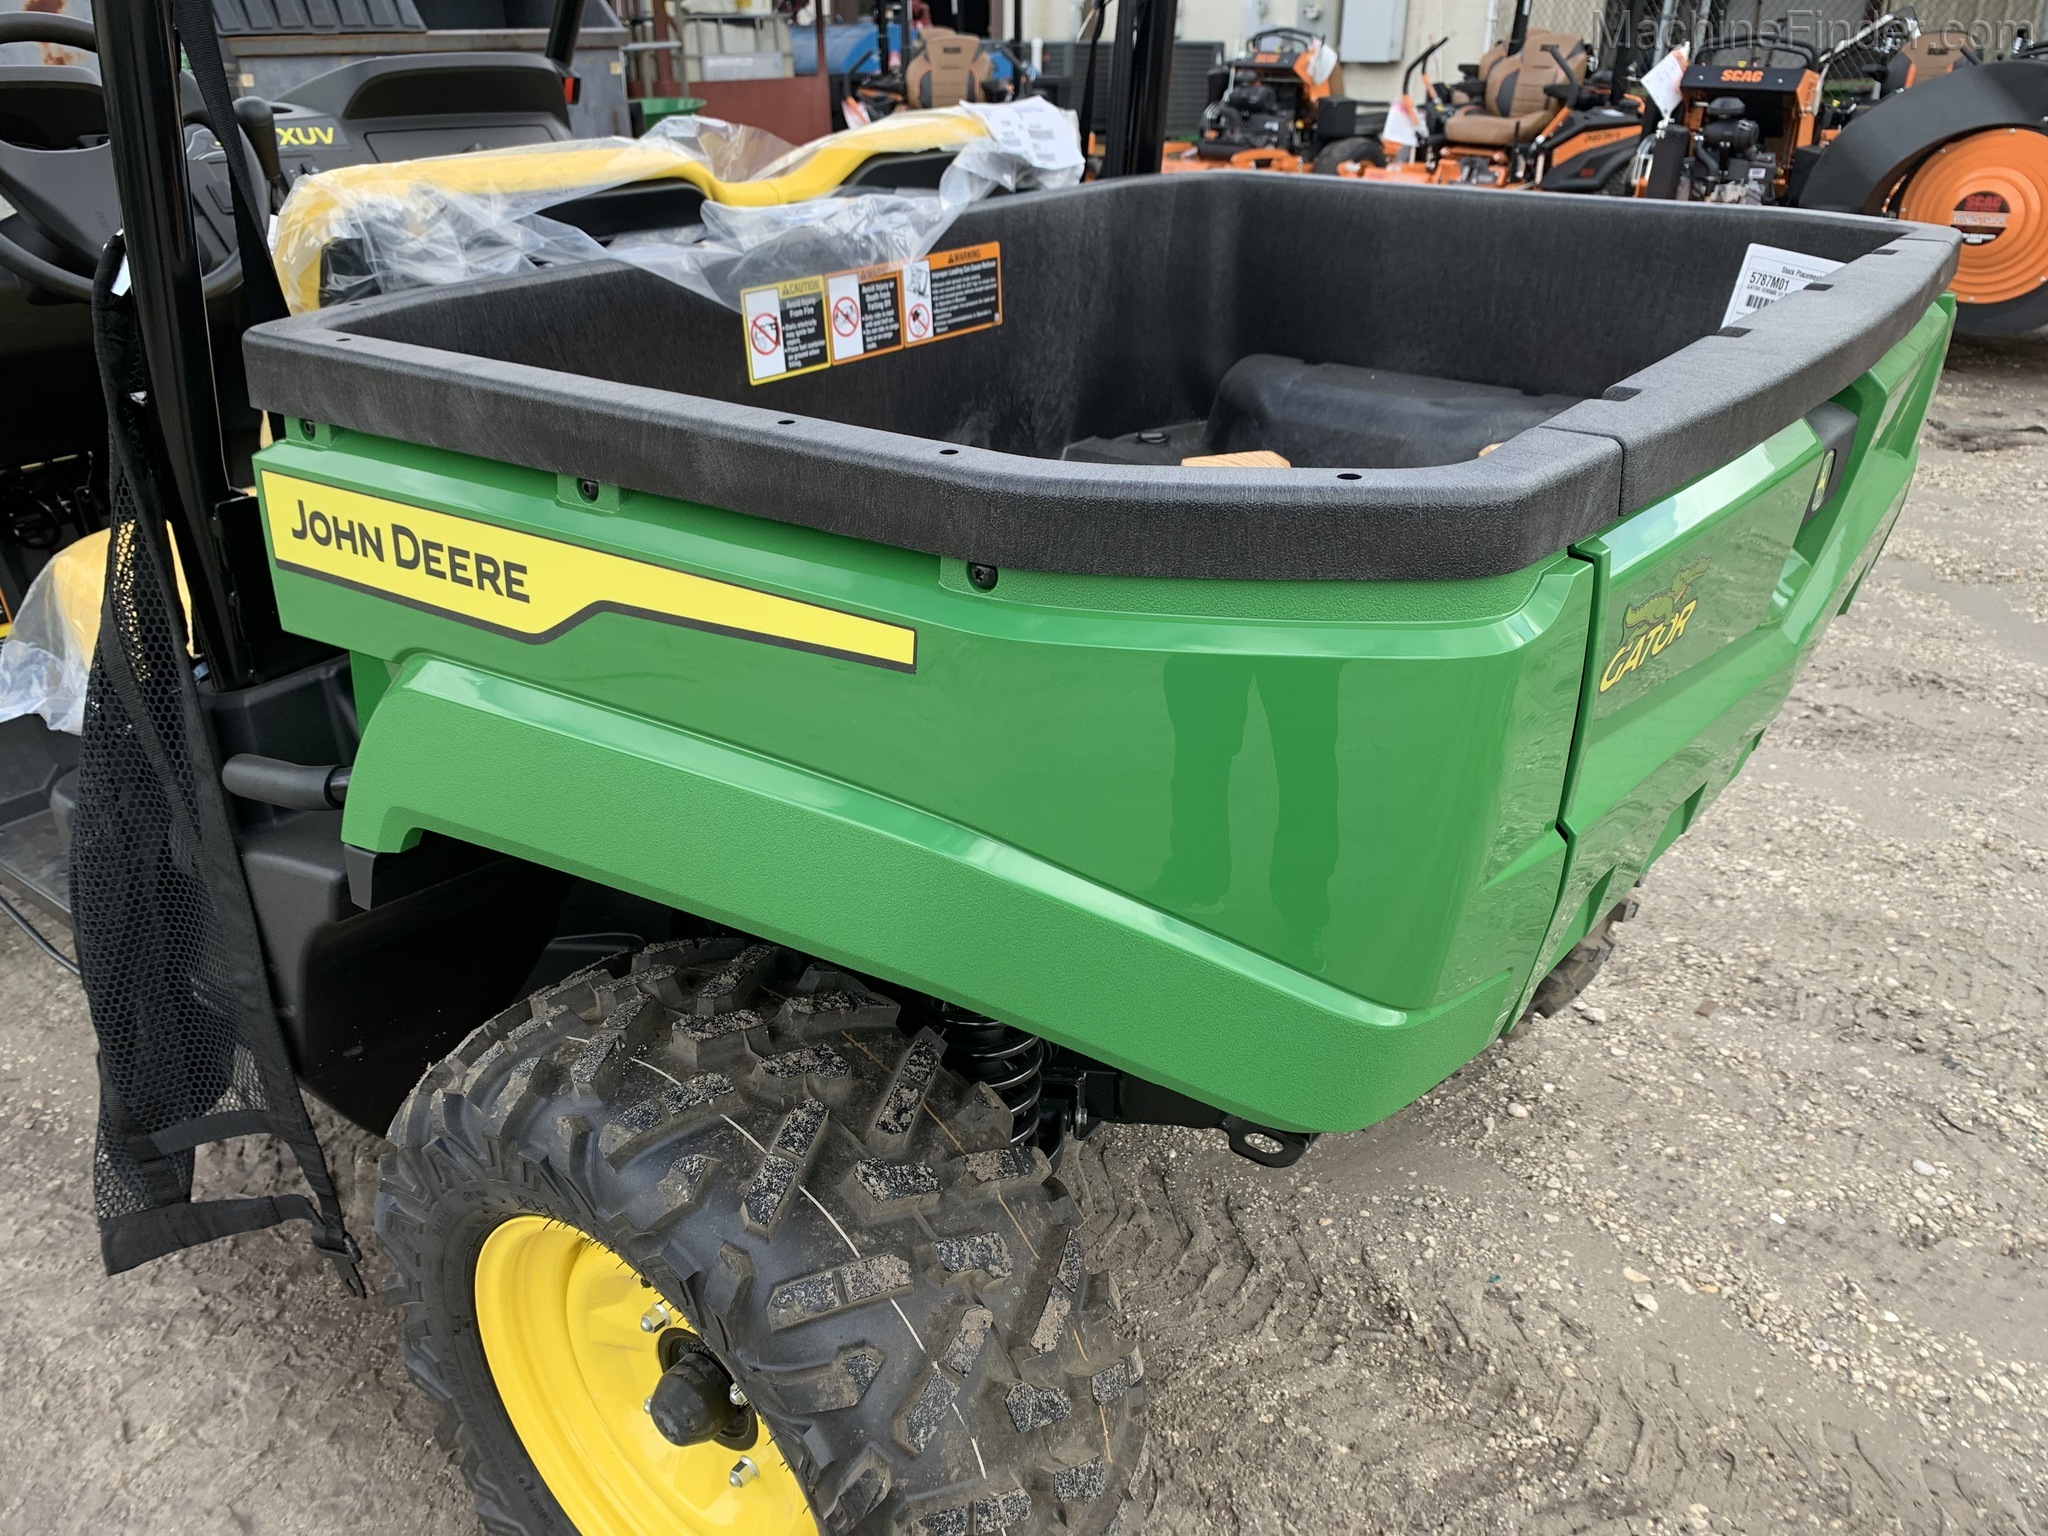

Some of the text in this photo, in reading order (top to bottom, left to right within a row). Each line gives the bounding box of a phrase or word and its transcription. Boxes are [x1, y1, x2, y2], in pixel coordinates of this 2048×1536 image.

[1720, 69, 1764, 83] SCAG
[275, 126, 335, 146] XUV
[954, 248, 982, 263] WARNING
[1781, 265, 1795, 275] Stock
[788, 279, 820, 295] CAUTION
[1749, 271, 1790, 291] 5787M01
[291, 499, 530, 604] JOHN DEERE
[1599, 599, 1697, 693] GATOR
